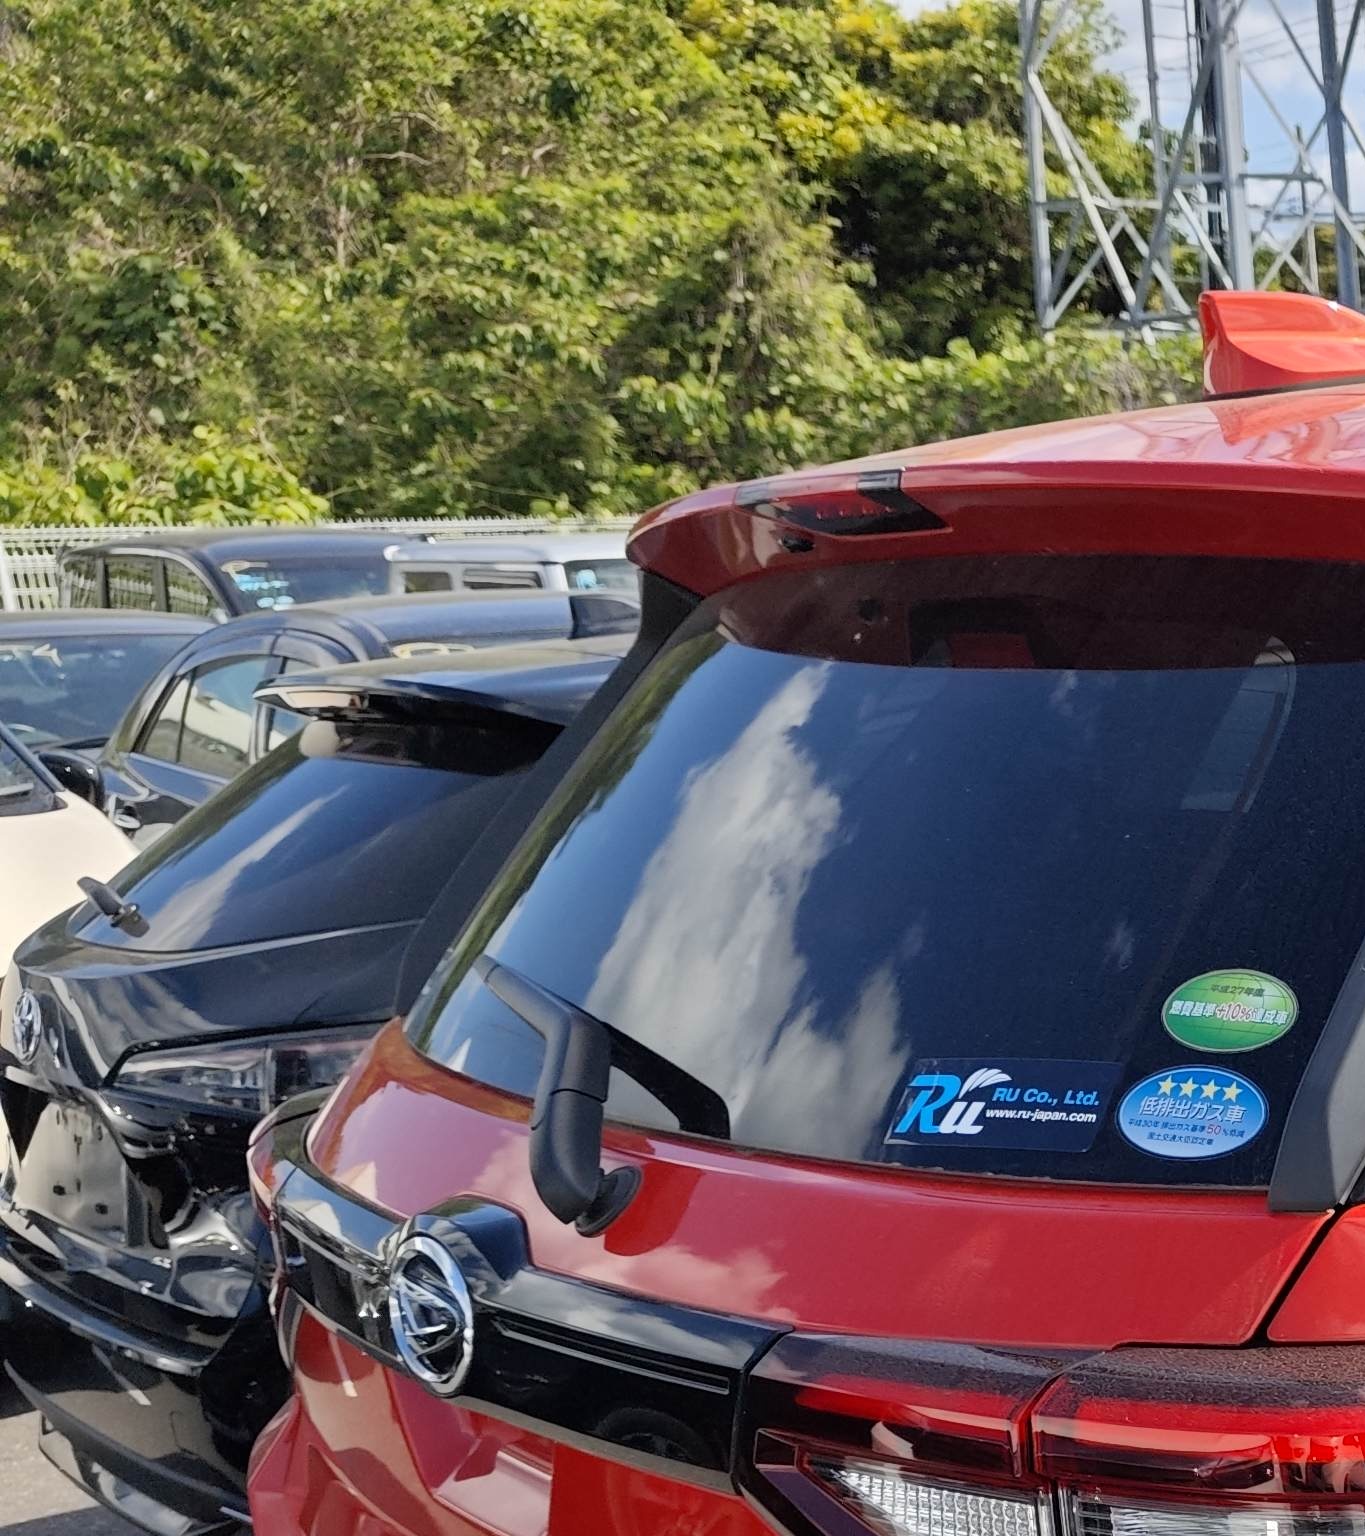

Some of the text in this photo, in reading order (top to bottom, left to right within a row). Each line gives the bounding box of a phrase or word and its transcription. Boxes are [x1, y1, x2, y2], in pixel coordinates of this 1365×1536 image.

[992, 1087, 1100, 1106] RU Co., Ltd.
[985, 1107, 1097, 1123] www.ru-japan.com
[1138, 1095, 1248, 1125] 低排出ガス車
